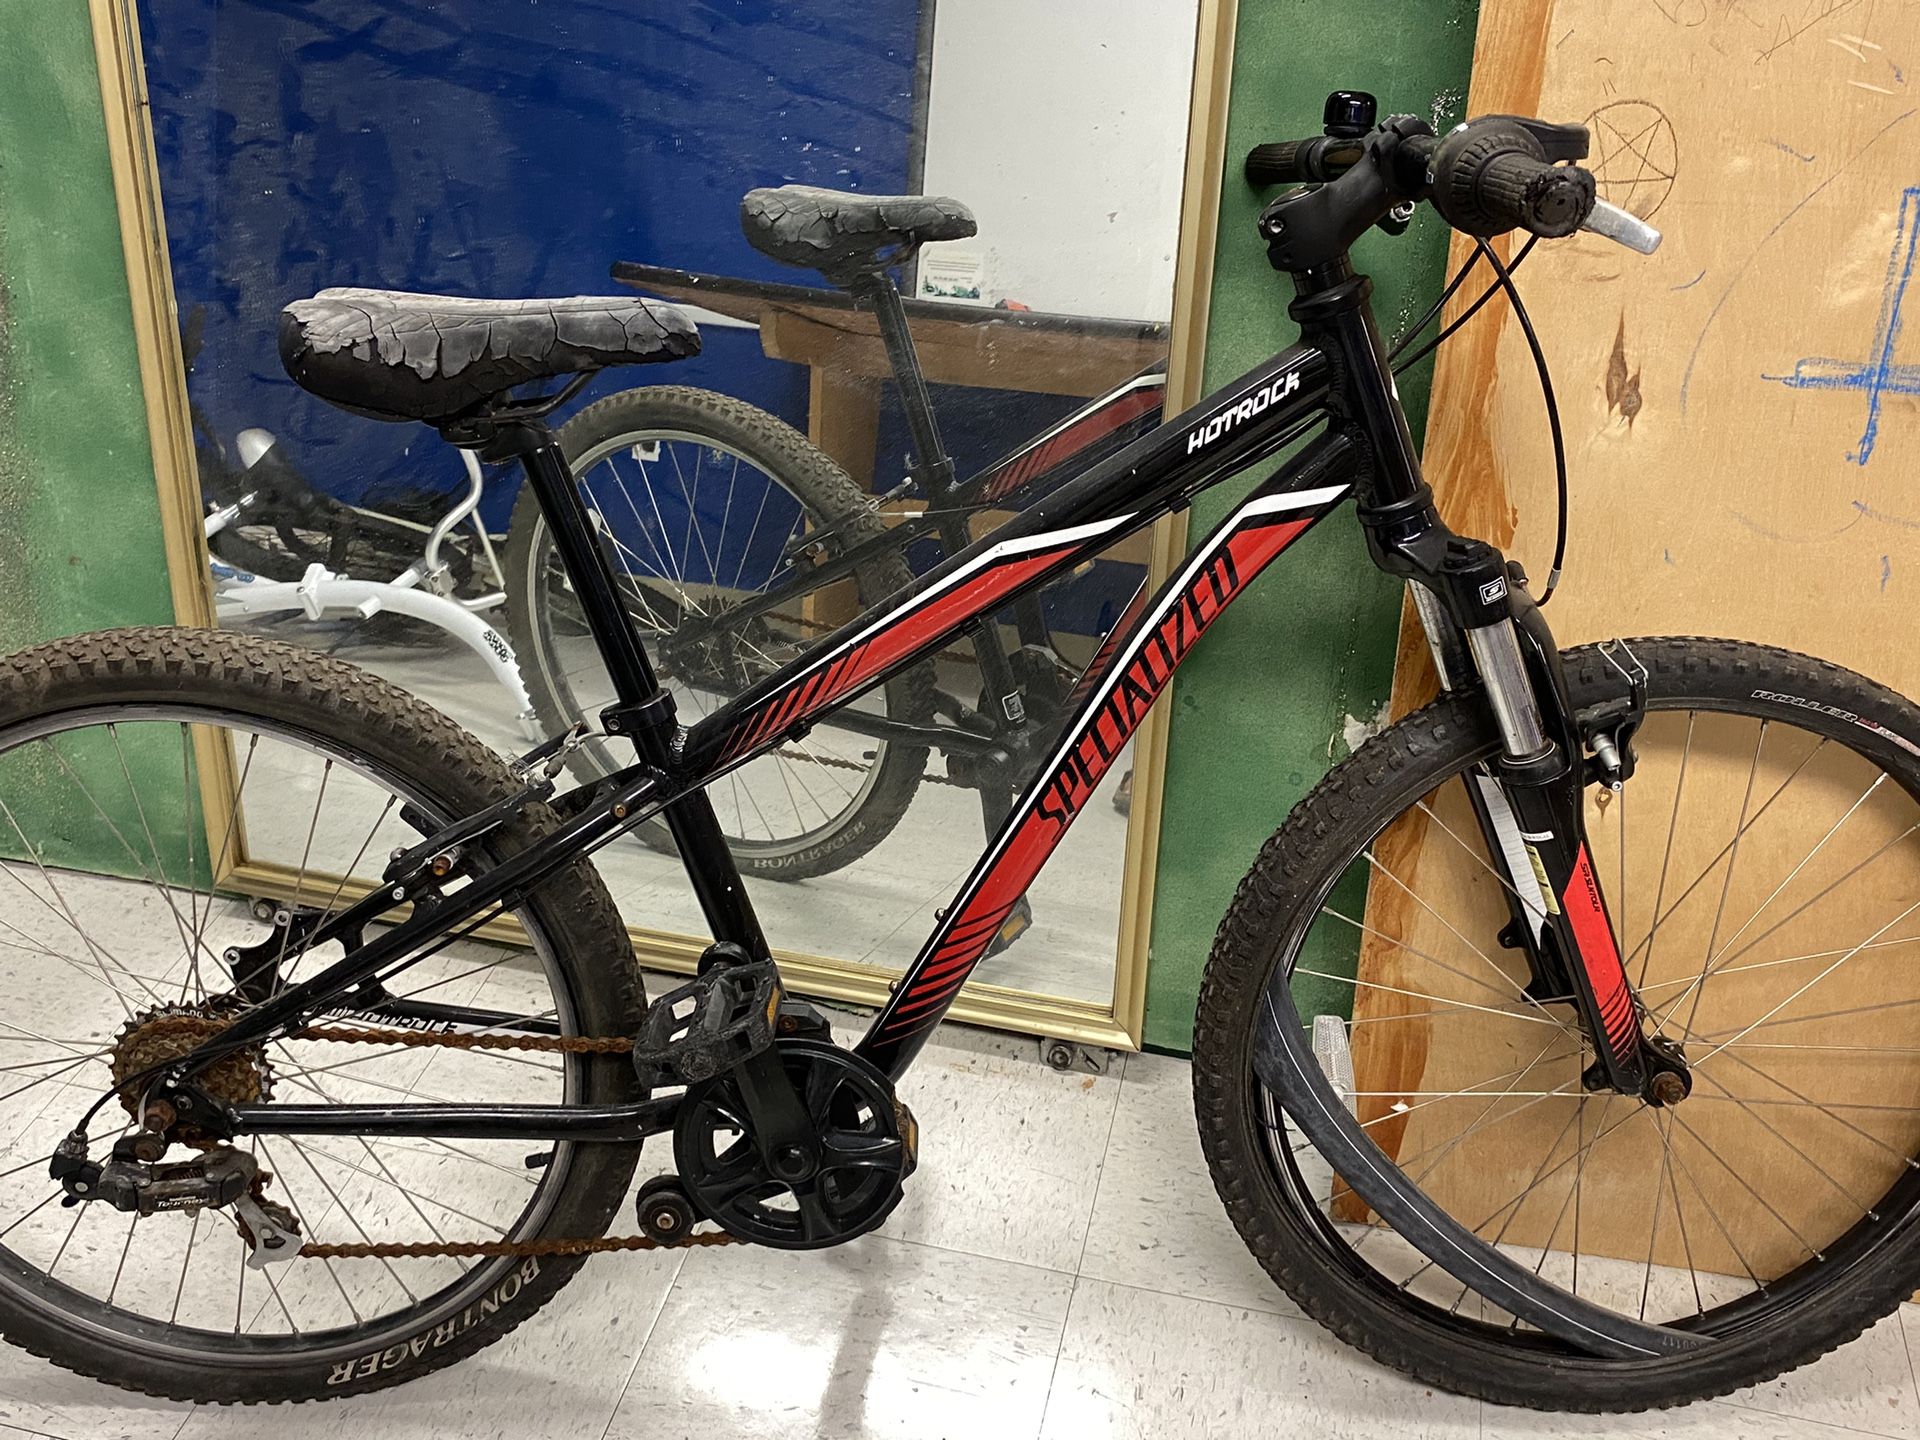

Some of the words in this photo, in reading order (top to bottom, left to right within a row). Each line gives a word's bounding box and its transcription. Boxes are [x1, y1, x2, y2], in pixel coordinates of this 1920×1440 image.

[1187, 371, 1302, 455] HOTROCK
[1036, 547, 1241, 828] SPECIALIZED
[1751, 689, 1860, 724] ROLLER
[327, 1255, 542, 1386] BONTRAGER
